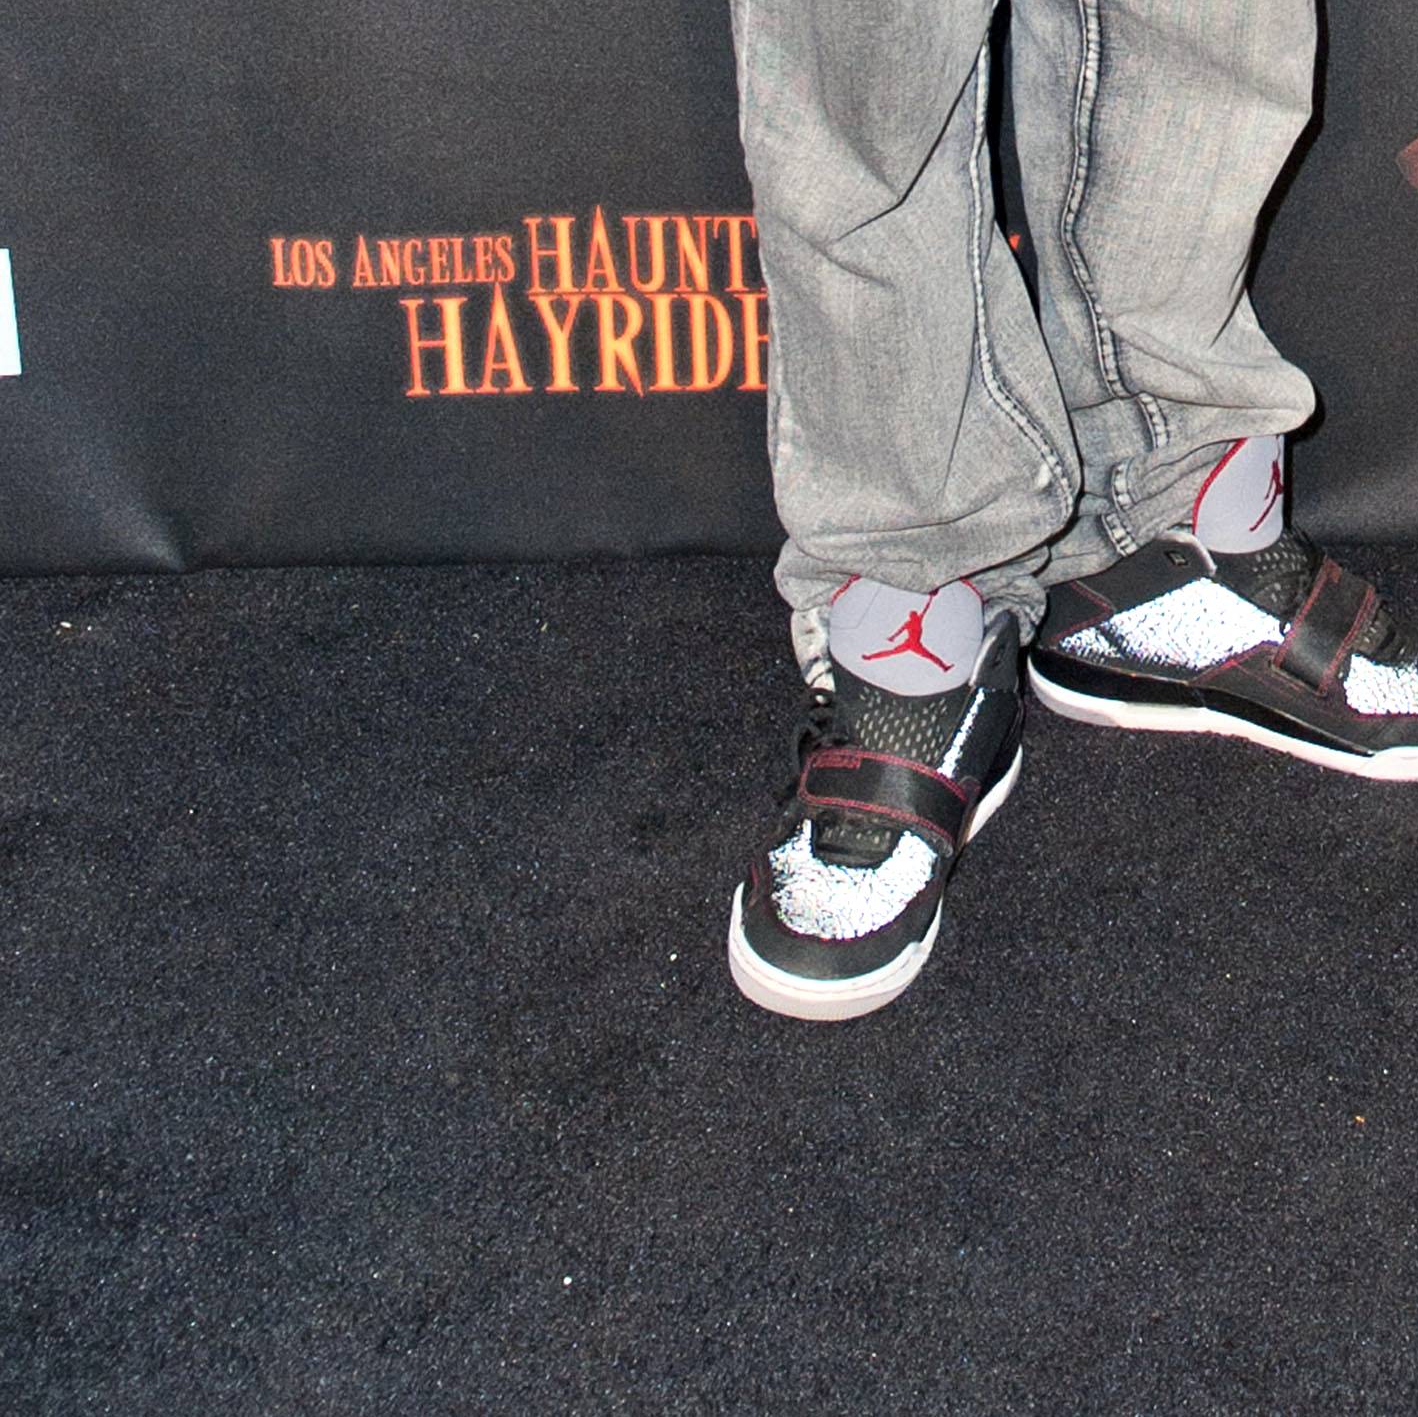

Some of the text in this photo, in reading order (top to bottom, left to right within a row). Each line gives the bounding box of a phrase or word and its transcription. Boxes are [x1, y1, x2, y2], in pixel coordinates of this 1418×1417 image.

[268, 205, 769, 295] LOS ANGELES HAUNT
